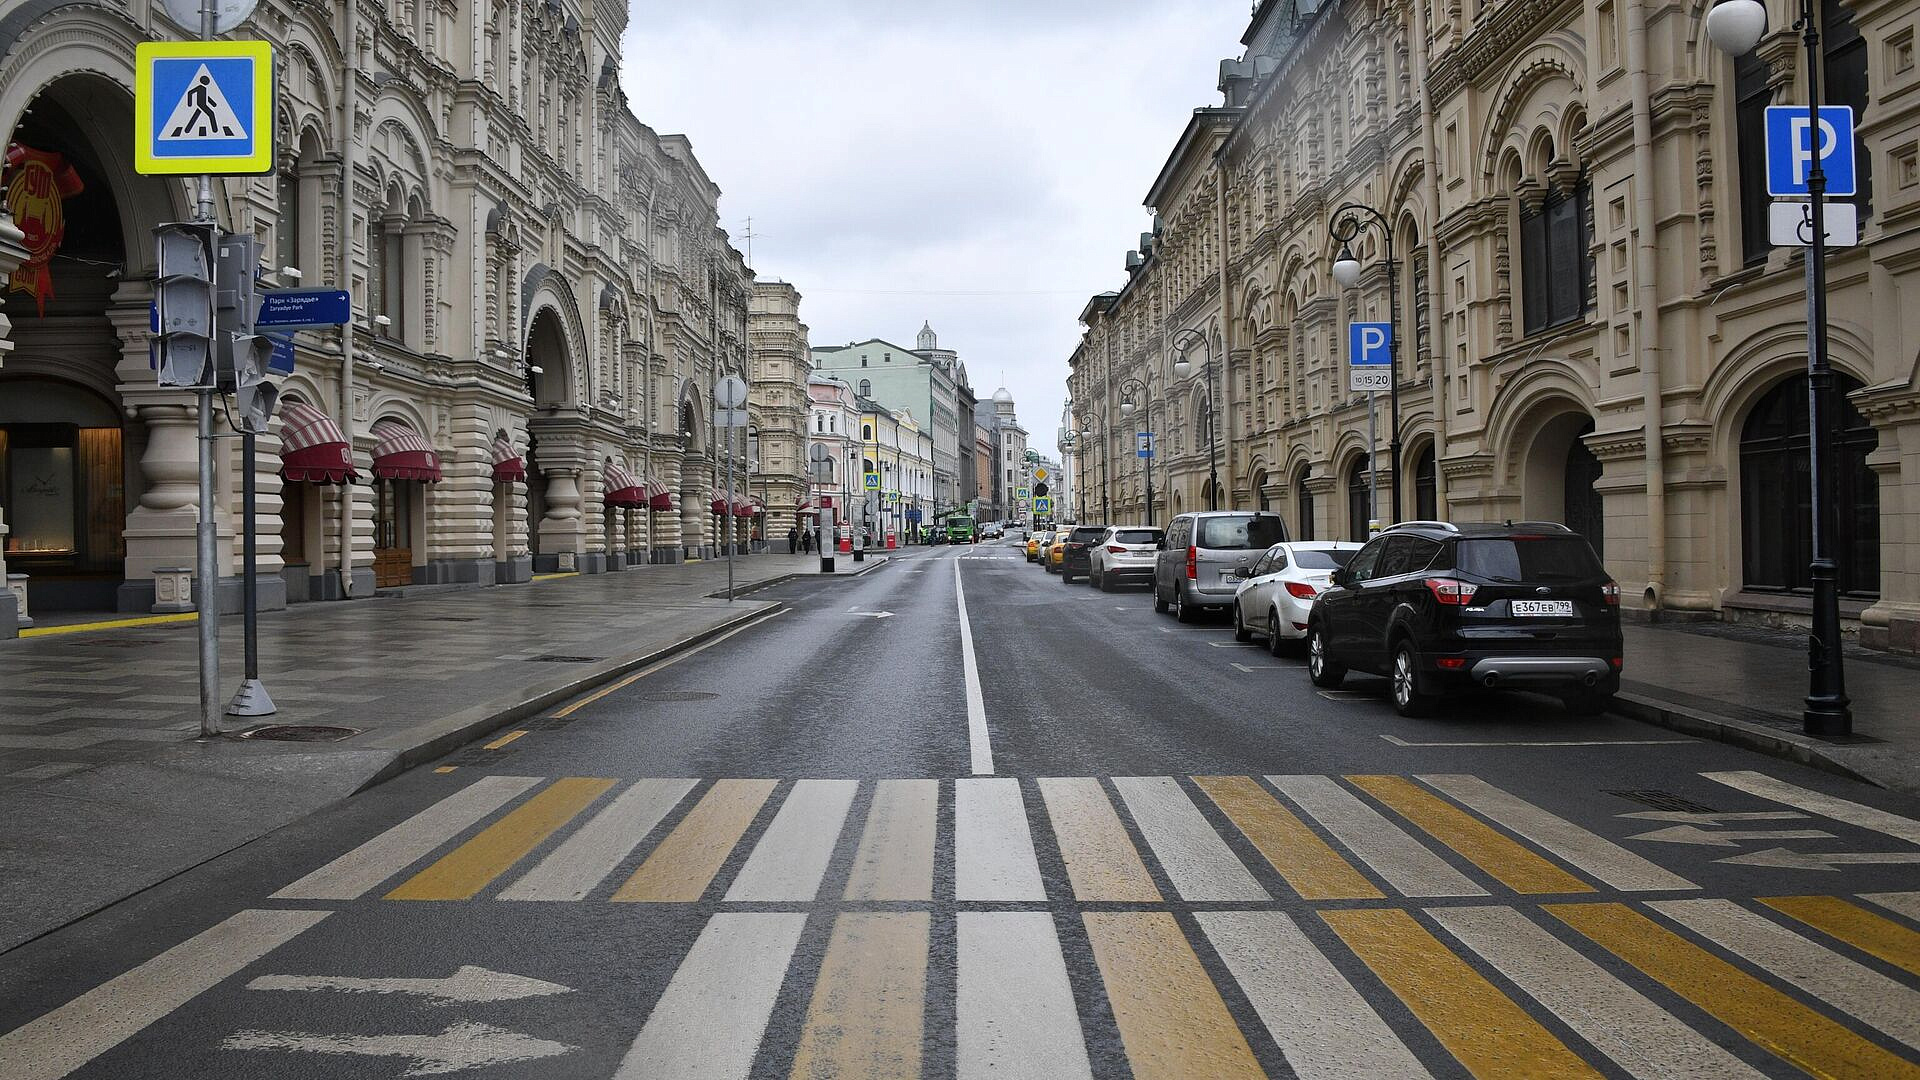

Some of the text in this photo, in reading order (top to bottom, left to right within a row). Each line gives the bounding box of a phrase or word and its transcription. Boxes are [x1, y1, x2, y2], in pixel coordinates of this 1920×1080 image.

[1790, 117, 1837, 185] P
[1361, 327, 1385, 361] P
[1364, 376, 1372, 384] 15
[1375, 375, 1388, 385] 20
